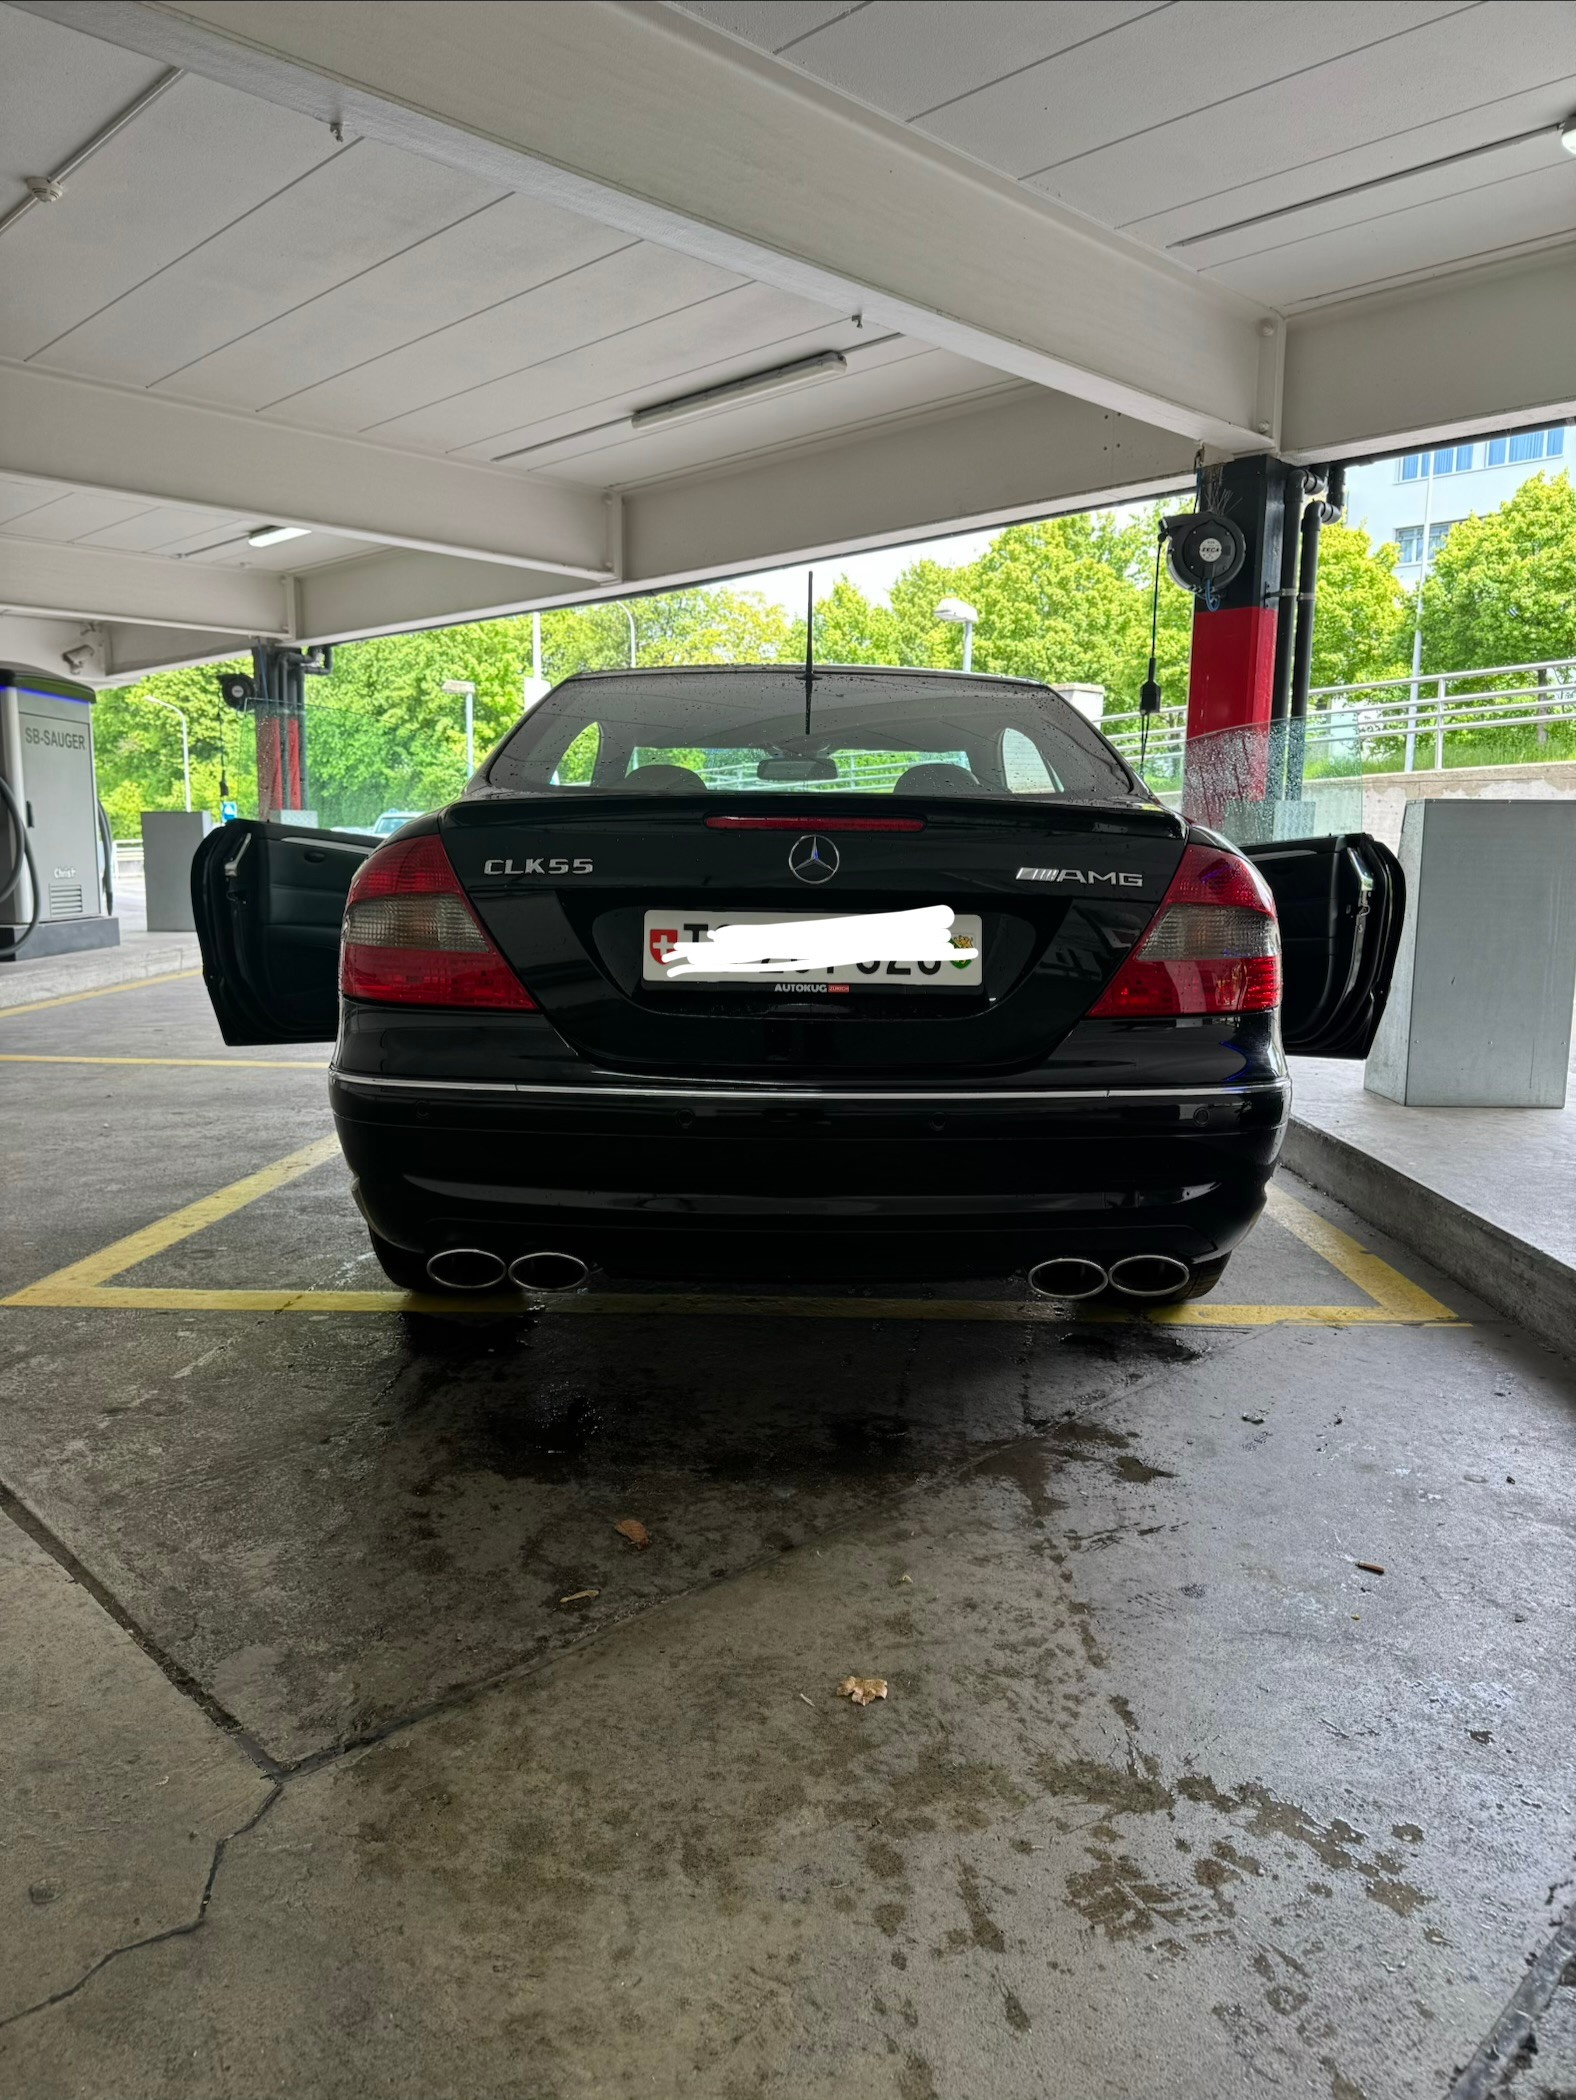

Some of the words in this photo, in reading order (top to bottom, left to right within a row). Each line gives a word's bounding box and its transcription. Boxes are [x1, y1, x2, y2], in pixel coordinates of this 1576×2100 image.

[25, 727, 85, 750] SB-SAUGER
[483, 858, 594, 875] CLK55
[1056, 869, 1143, 887] AMG
[774, 983, 827, 993] AUTOKUG
